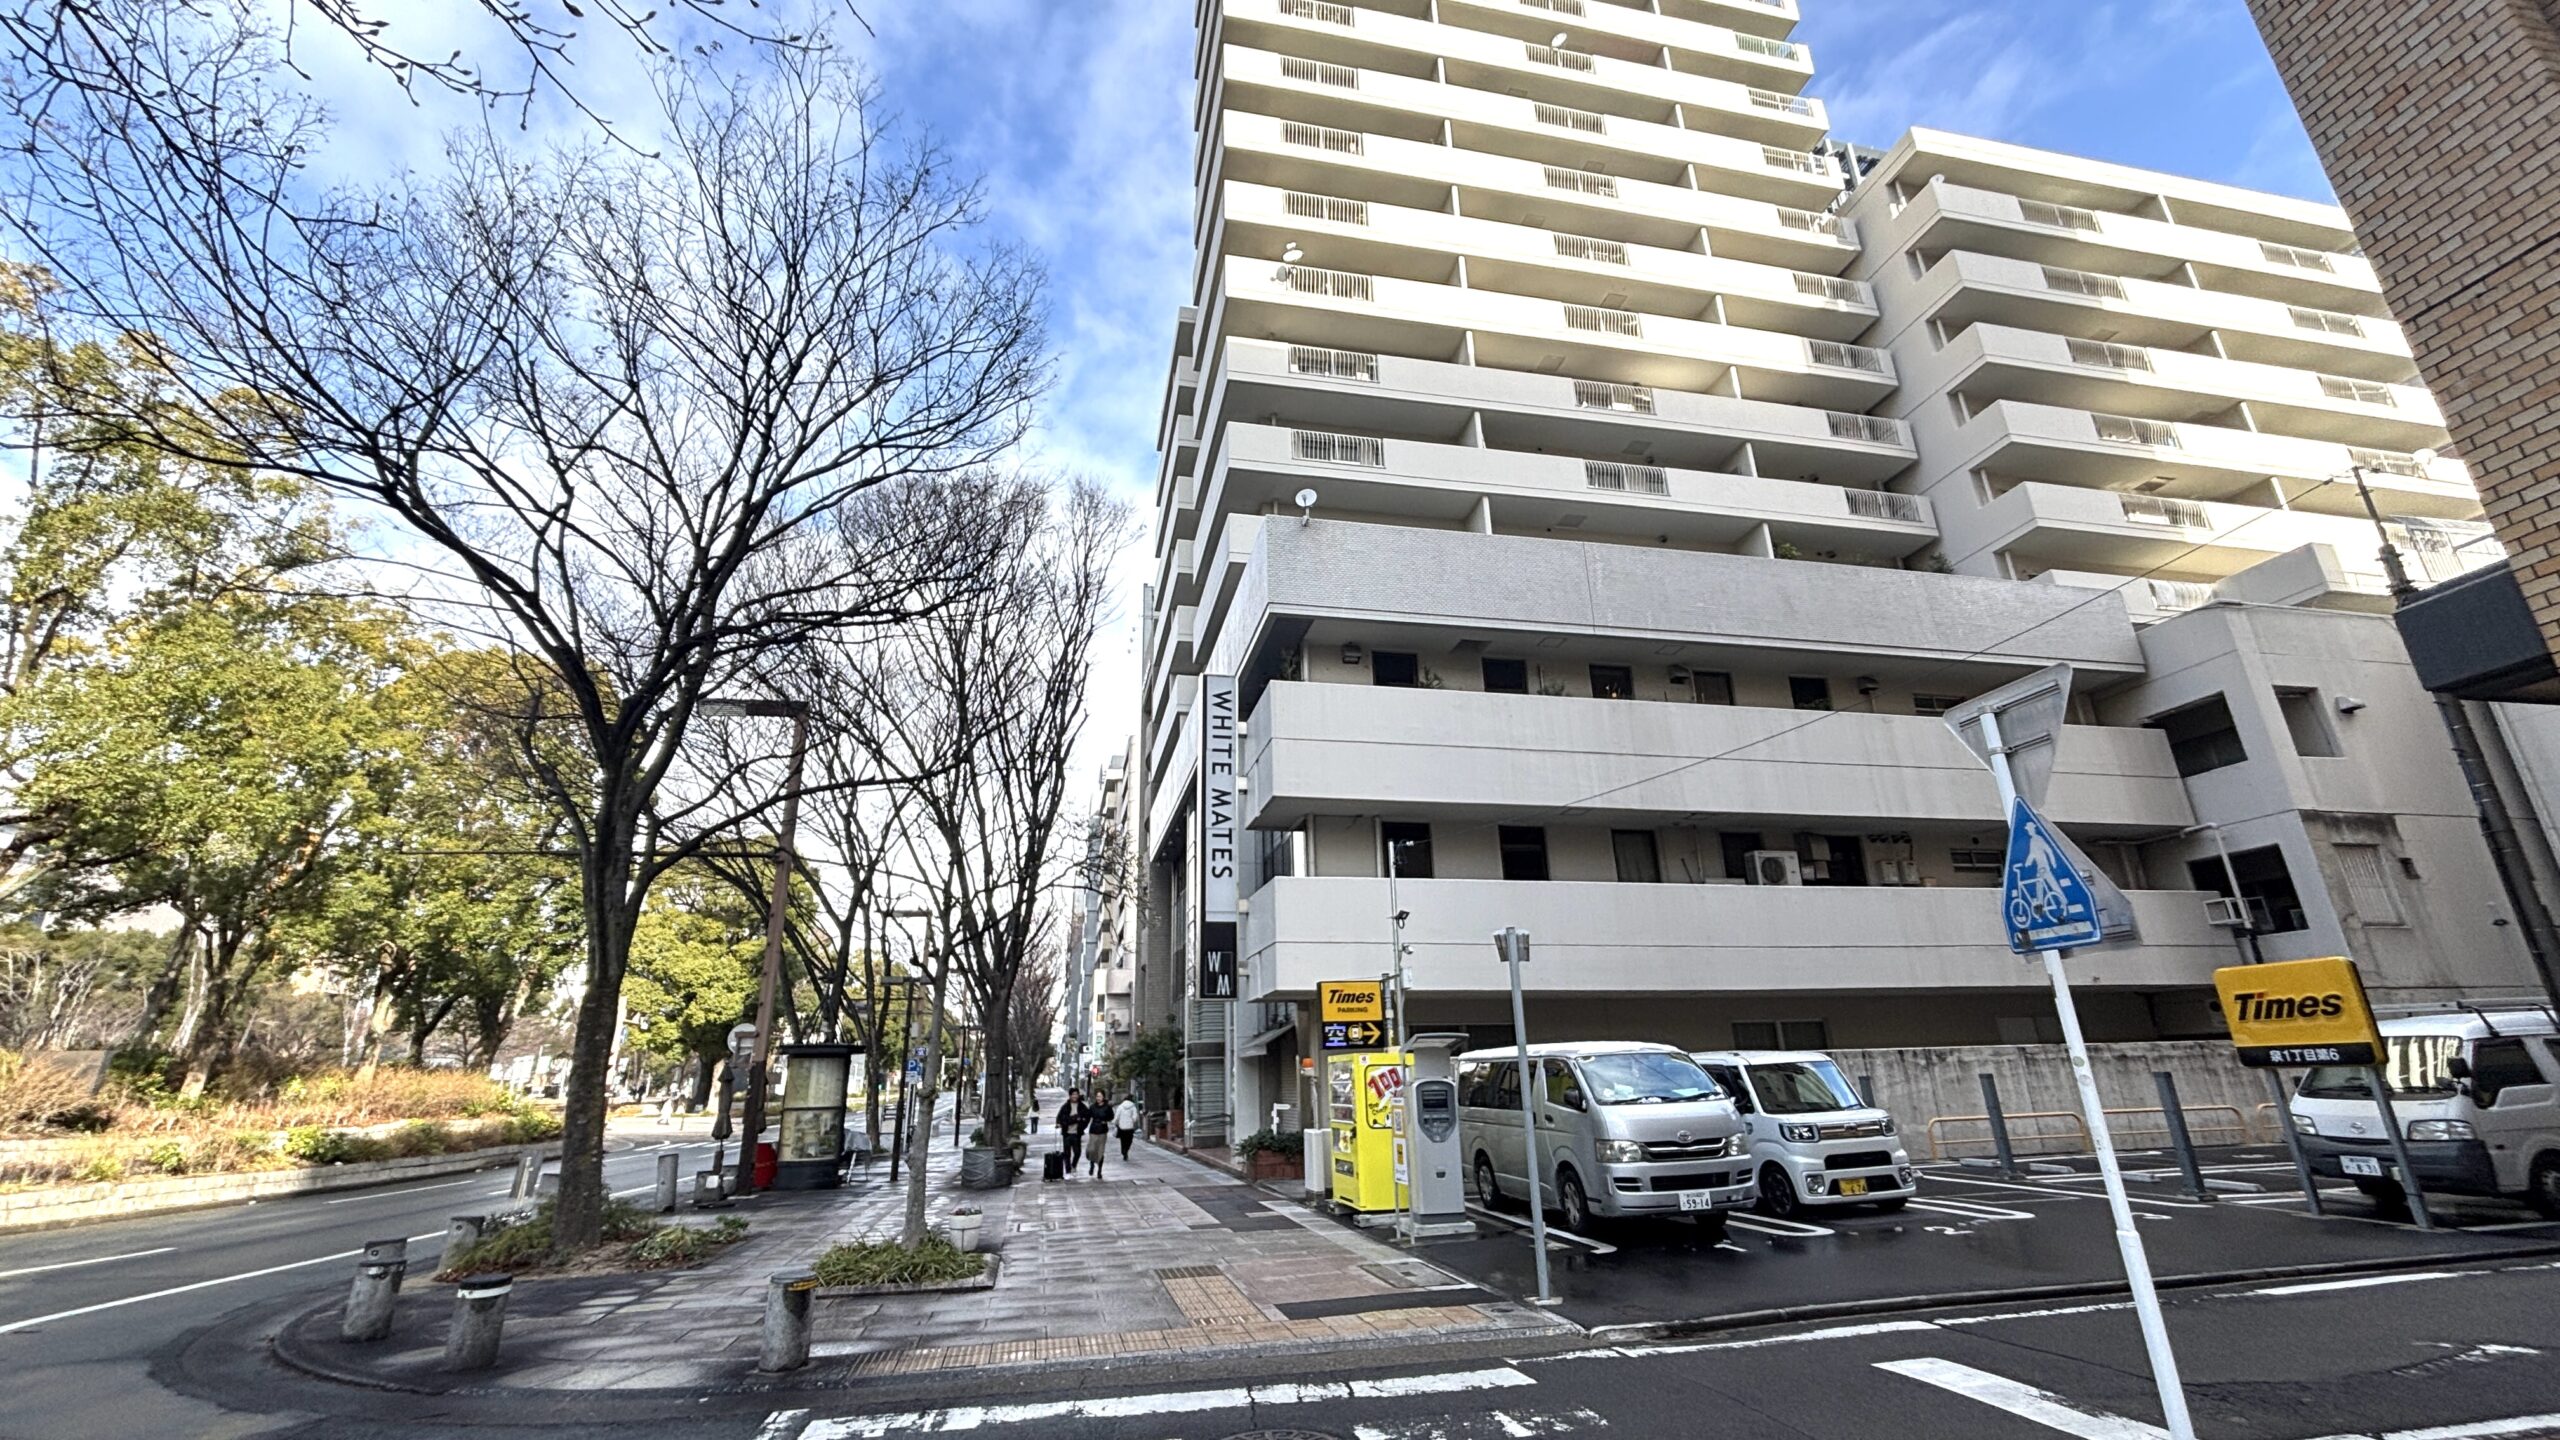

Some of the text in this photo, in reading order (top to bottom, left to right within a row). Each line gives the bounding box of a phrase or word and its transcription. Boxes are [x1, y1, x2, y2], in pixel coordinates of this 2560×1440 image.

[1211, 690, 1233, 879] WHITE MATES
[1328, 989, 1376, 1004] Times
[1337, 1006, 1369, 1014] PARKING
[2233, 992, 2345, 1022] Times
[1324, 1023, 1348, 1047] 空
[908, 1060, 917, 1071] P
[1367, 1066, 1403, 1100] 100
[1686, 1198, 1710, 1209] 59-14
